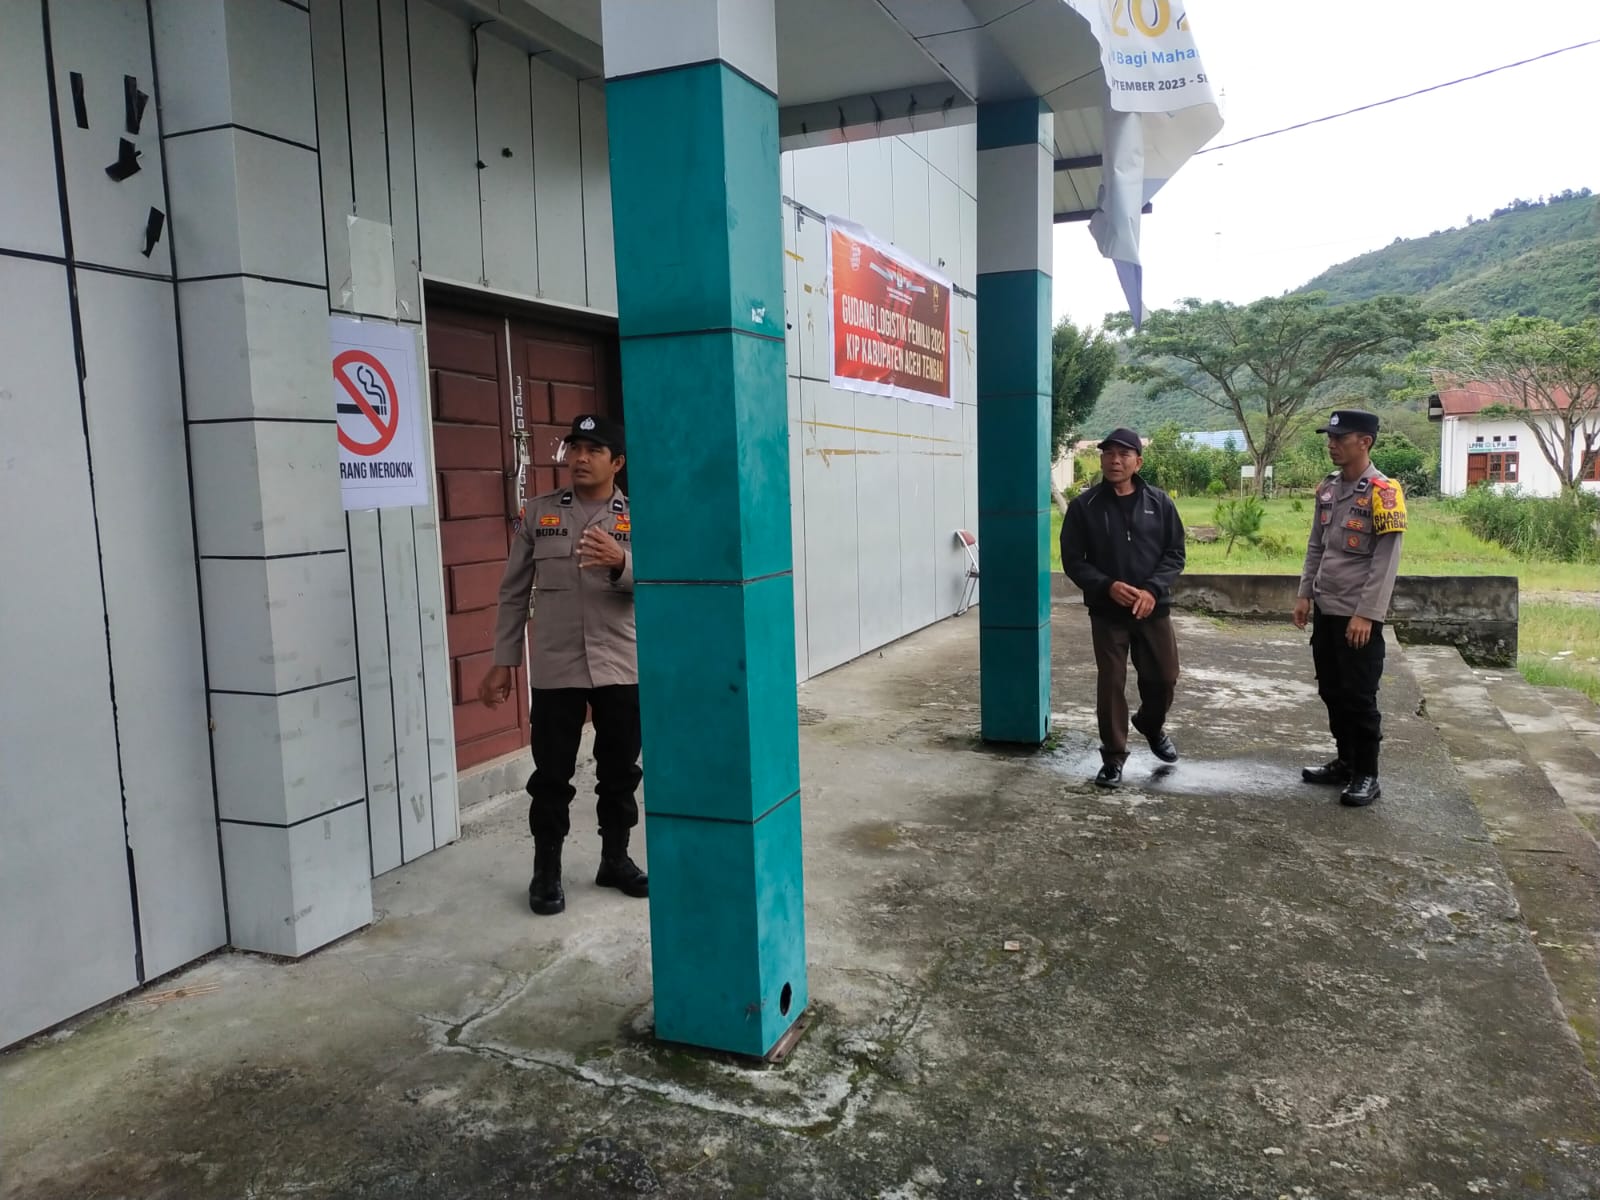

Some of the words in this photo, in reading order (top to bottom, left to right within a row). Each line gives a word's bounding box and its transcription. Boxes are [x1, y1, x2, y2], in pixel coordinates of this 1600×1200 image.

[1117, 50, 1147, 68] Bagi
[1158, 77, 1186, 91] 2023
[842, 294, 875, 330] GUDANG
[876, 306, 907, 342] LOGISTIK
[908, 317, 930, 350] PEMILU
[931, 325, 946, 355] 2024
[846, 333, 860, 360] KIP
[861, 337, 904, 371] KABUPATEN
[905, 351, 921, 377] ACEH
[922, 355, 944, 383] TENGAH
[369, 462, 414, 479] MEROKOK
